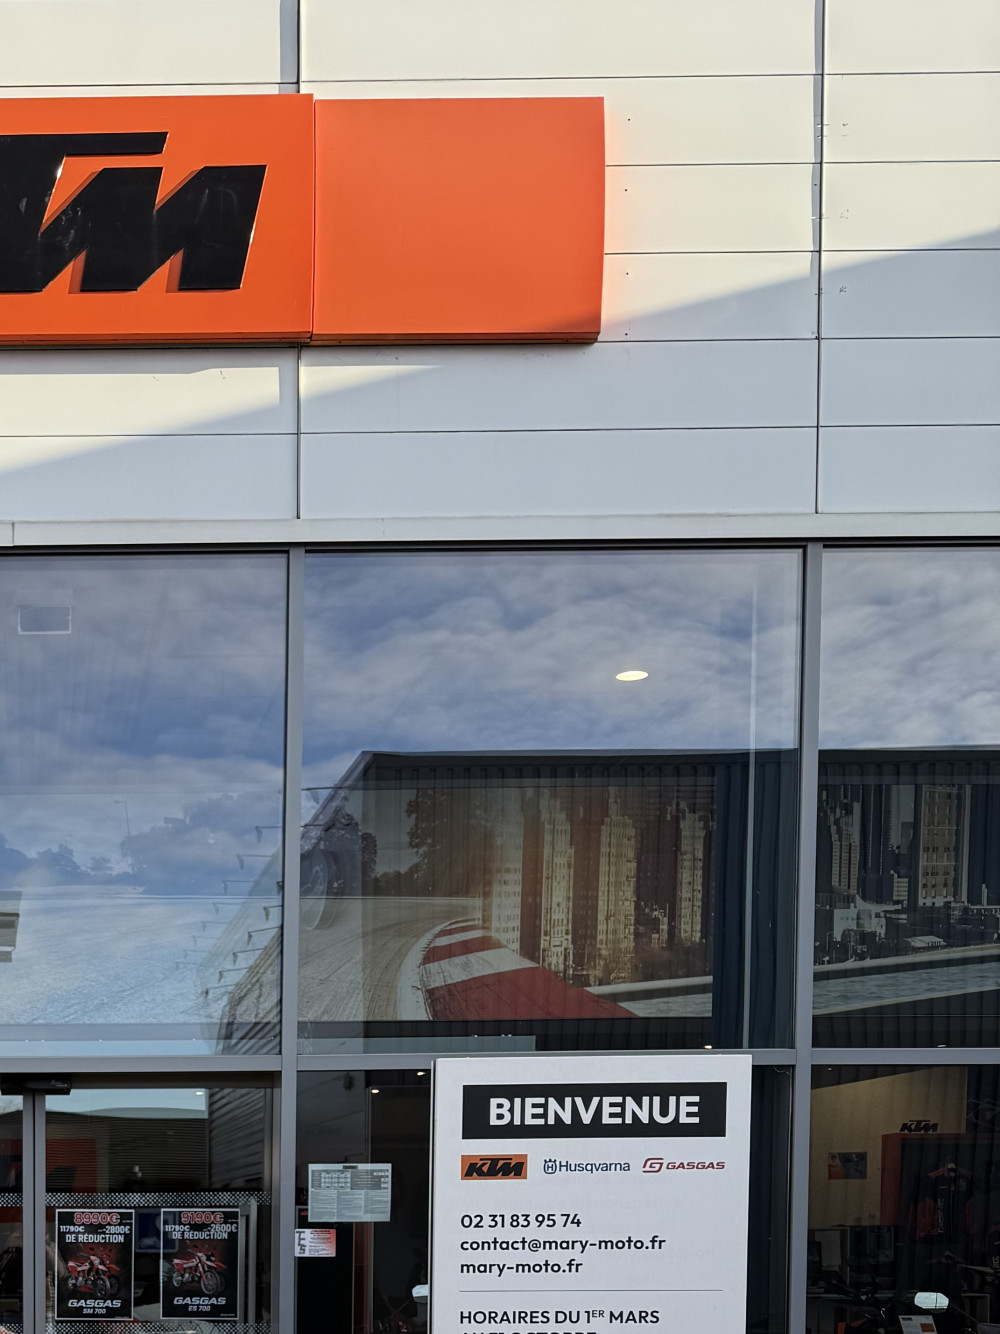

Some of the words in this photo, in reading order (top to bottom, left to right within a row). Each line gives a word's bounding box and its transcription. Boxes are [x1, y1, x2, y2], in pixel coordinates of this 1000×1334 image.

[490, 1096, 699, 1125] BIENVENUE
[900, 1120, 939, 1132] KTM
[464, 1158, 525, 1178] KTM
[559, 1161, 630, 1173] Husqvarna
[74, 1212, 120, 1224] 8990€
[461, 1215, 483, 1228] 02
[488, 1214, 504, 1228] 31
[510, 1214, 530, 1228] 83
[535, 1214, 556, 1227] 95
[561, 1214, 581, 1227] 74
[79, 1233, 124, 1242] RÉDUCTION
[184, 1230, 228, 1239] RÉDUCTION
[461, 1235, 666, 1253] contact@mary-moto.fr
[461, 1259, 583, 1277] mary-moto.fr
[460, 1311, 550, 1324] HORAIRES
[555, 1311, 580, 1323] DU
[585, 1310, 604, 1323] 1ER
[610, 1311, 659, 1323] MARS
